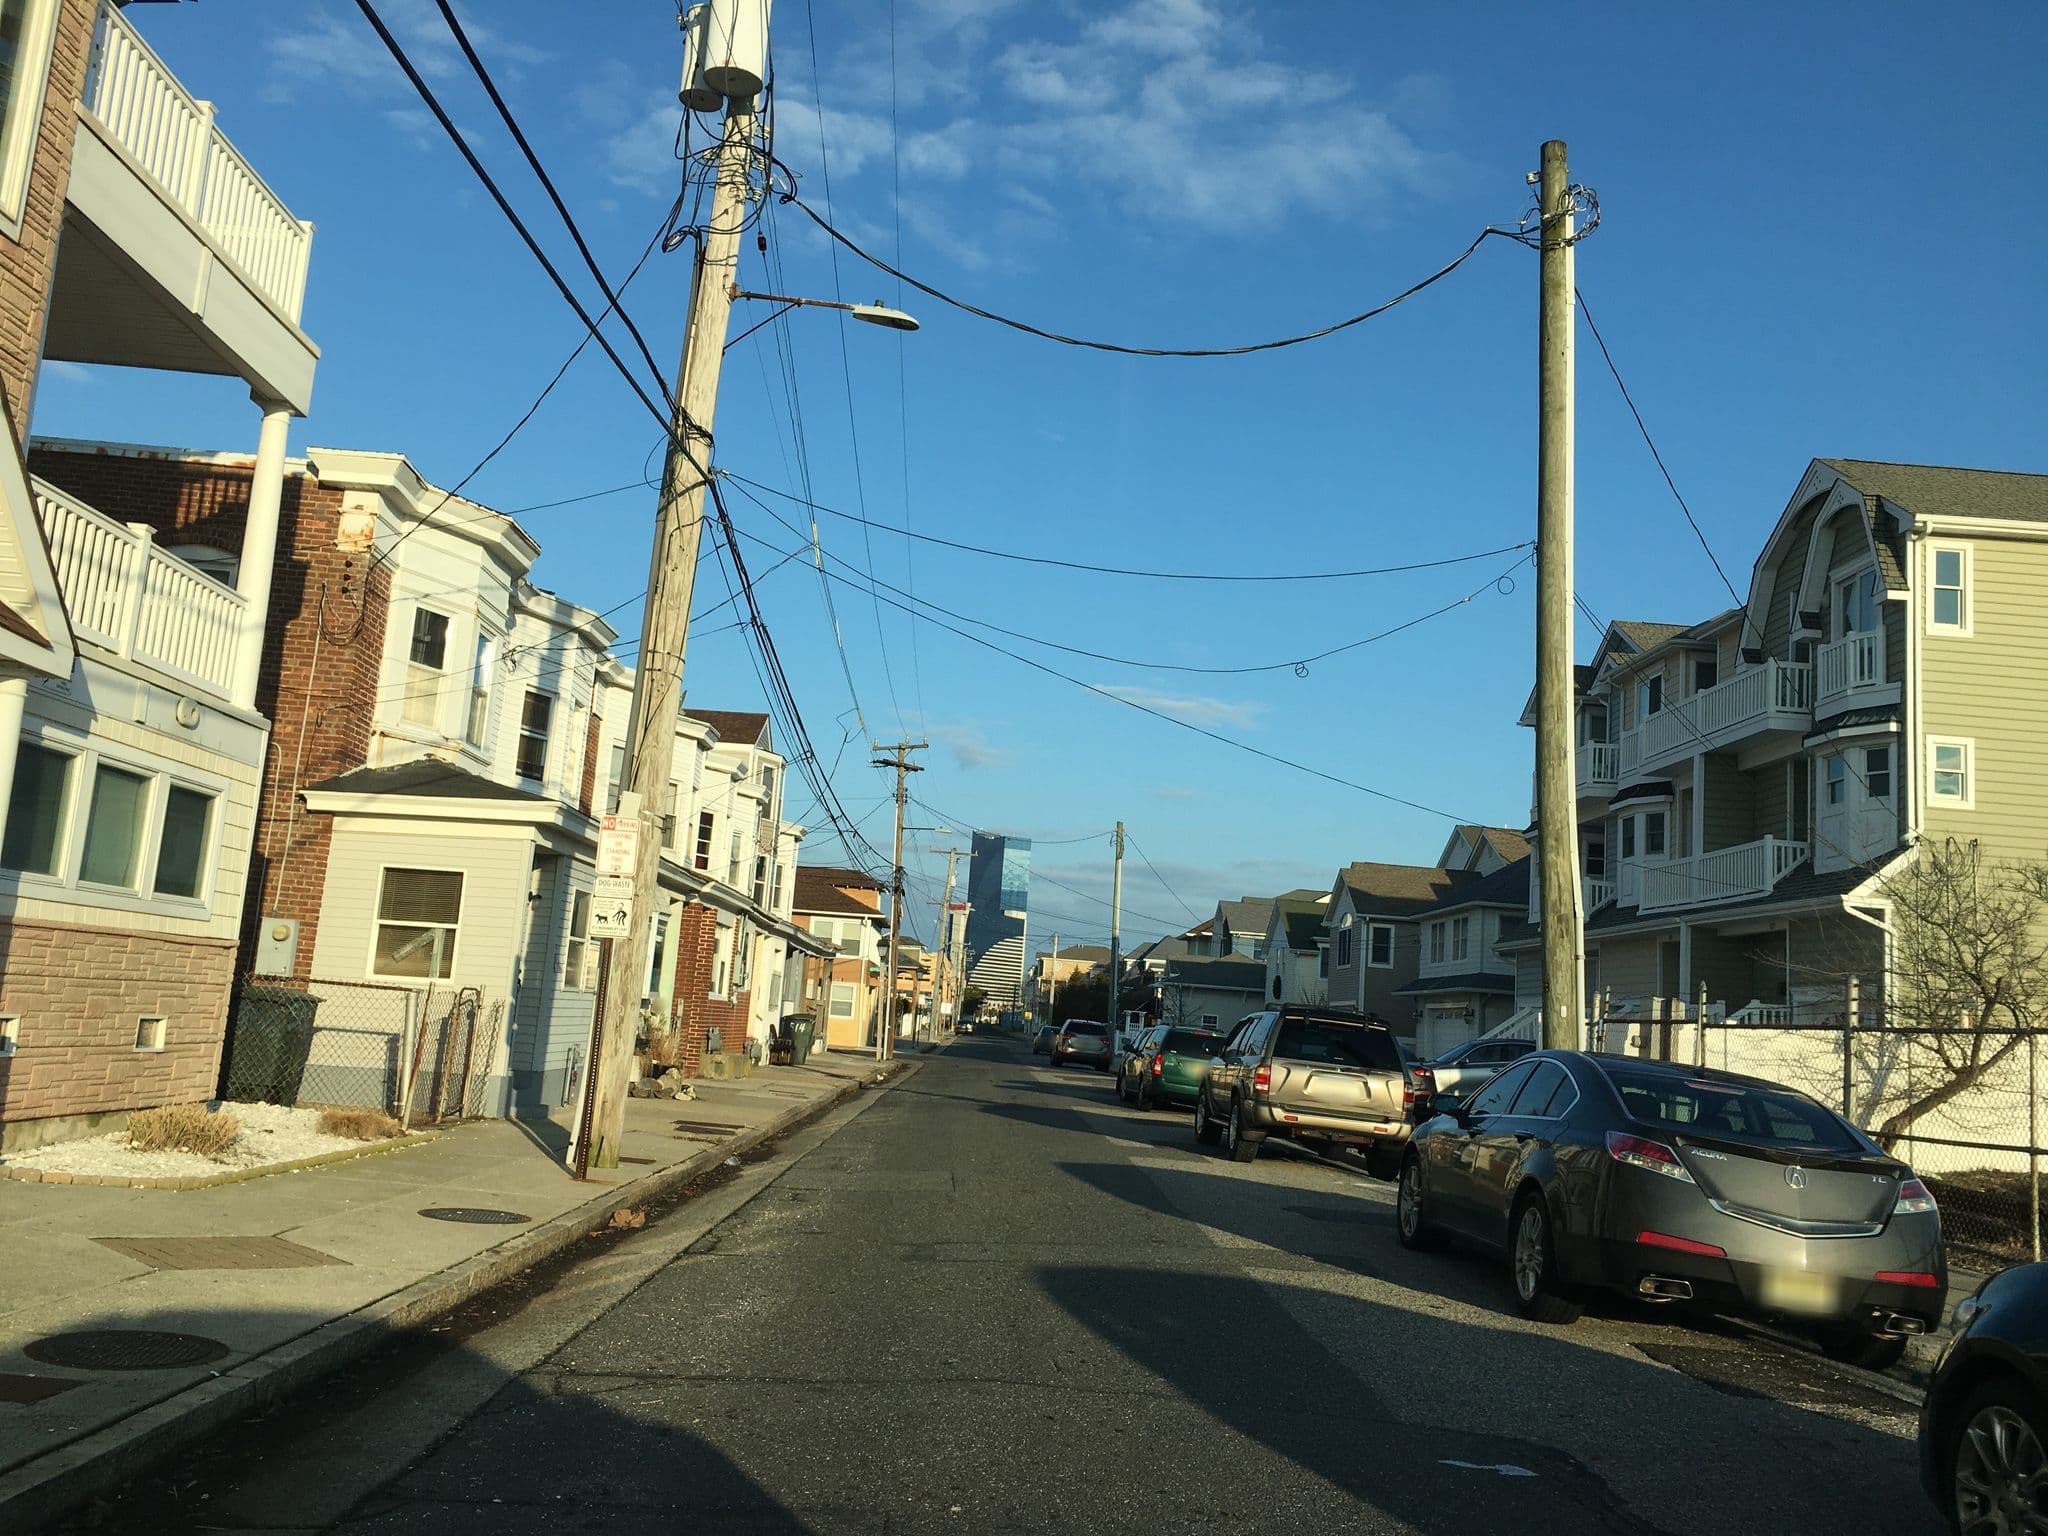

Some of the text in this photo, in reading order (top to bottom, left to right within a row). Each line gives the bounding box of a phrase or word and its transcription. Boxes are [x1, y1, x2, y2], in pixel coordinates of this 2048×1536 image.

[602, 817, 615, 829] NO
[598, 879, 630, 889] DOG WASTE
[1691, 1149, 1728, 1161] ACURA
